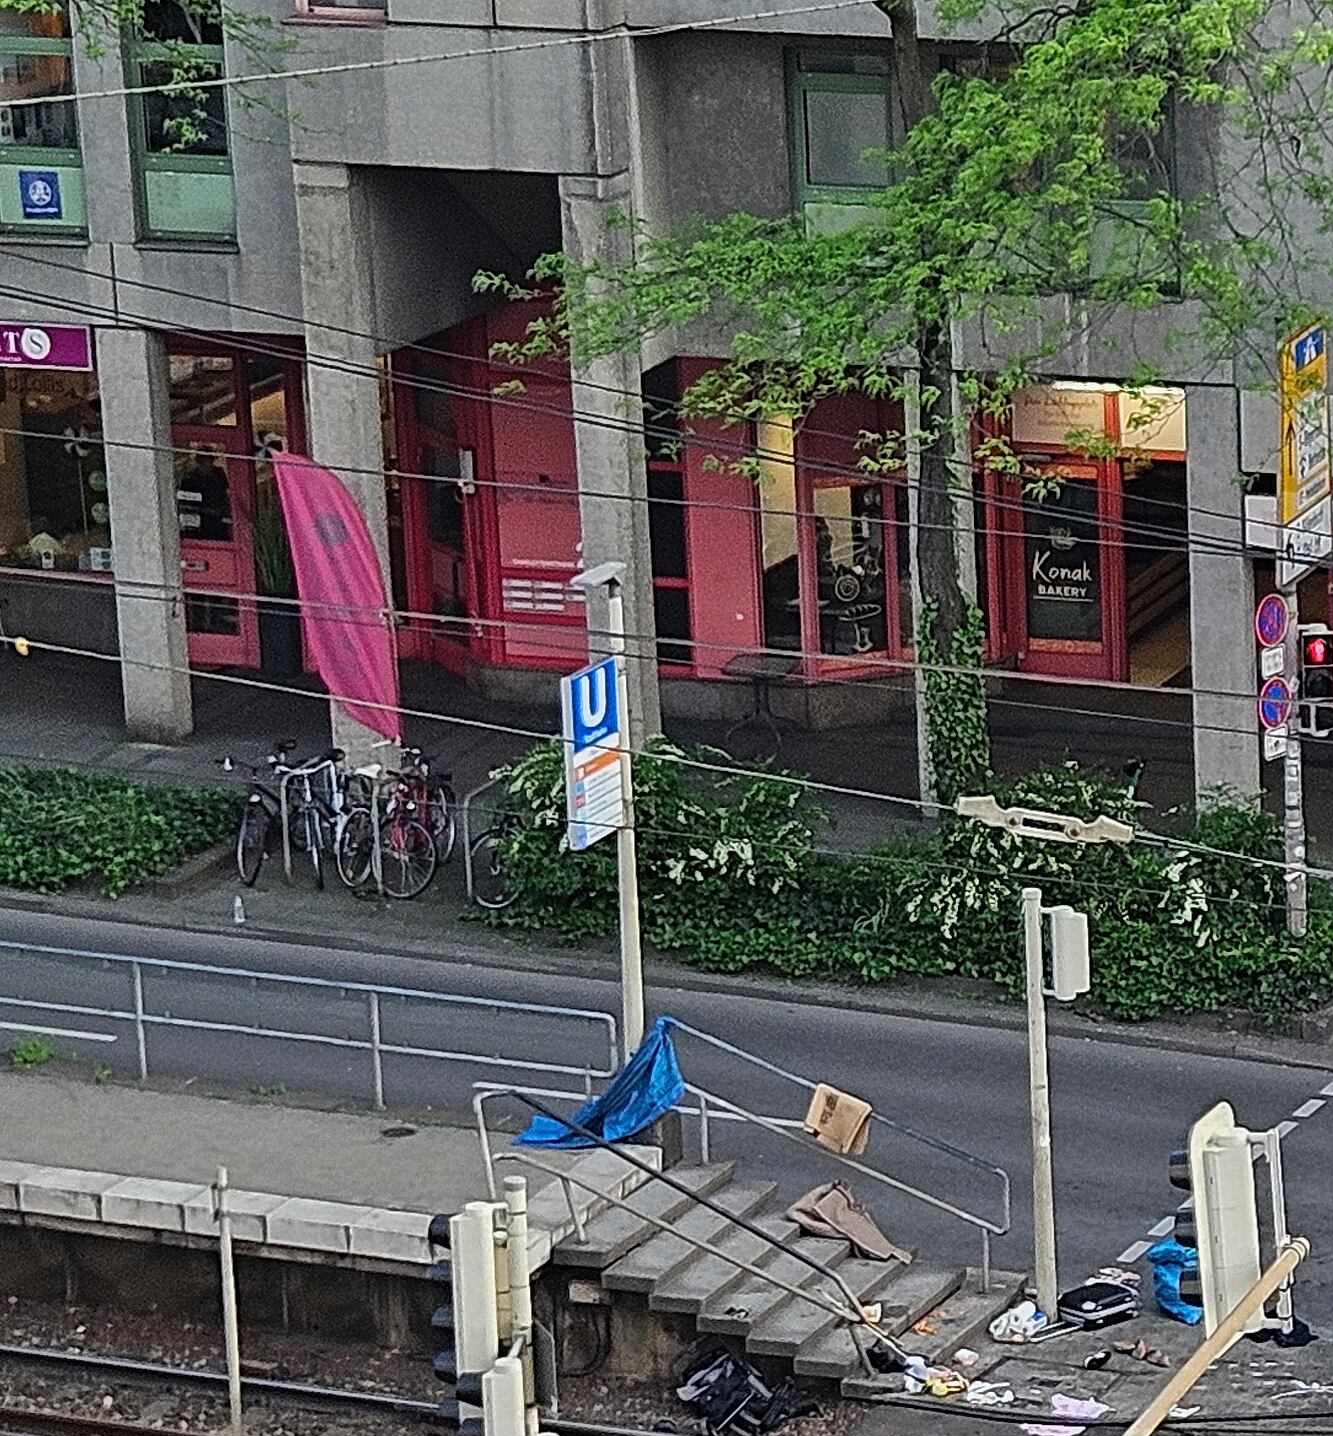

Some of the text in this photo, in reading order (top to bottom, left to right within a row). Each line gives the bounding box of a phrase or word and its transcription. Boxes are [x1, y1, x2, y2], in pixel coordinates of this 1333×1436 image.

[1032, 550, 1093, 583] Konak
[1037, 584, 1087, 598] BAKERY
[580, 667, 606, 728] U
